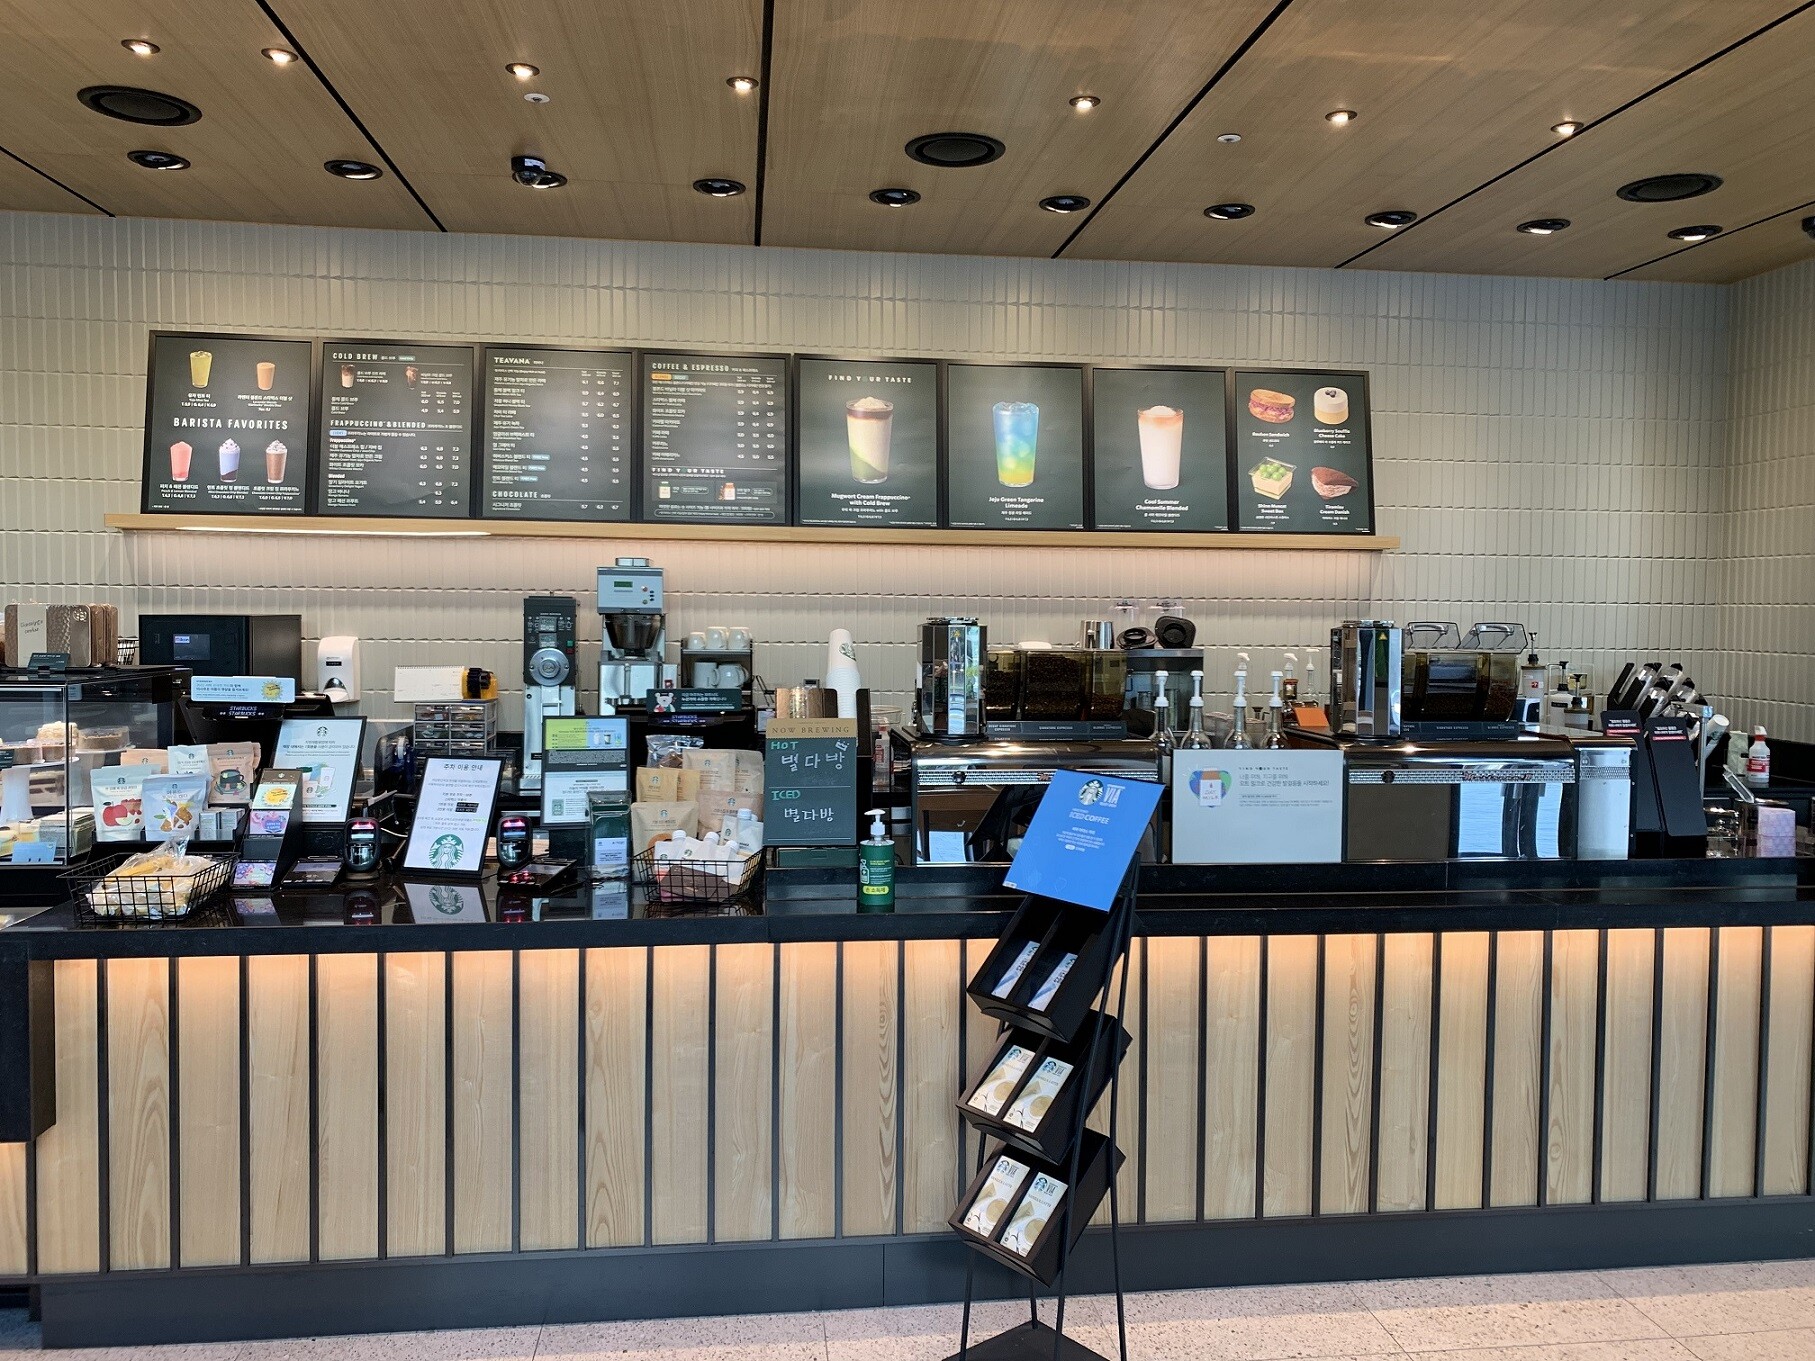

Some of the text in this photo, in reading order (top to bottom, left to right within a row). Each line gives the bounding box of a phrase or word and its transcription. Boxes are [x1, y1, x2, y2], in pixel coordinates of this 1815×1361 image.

[692, 364, 729, 372] ESPRESSO
[174, 418, 288, 429] BARISTA FAVORITES
[770, 741, 798, 750] HOT
[781, 752, 845, 772] 별다방
[771, 790, 801, 800] ICED
[1104, 787, 1121, 804] VIA
[784, 808, 834, 822] 별다방
[1084, 814, 1109, 824] COFFEE
